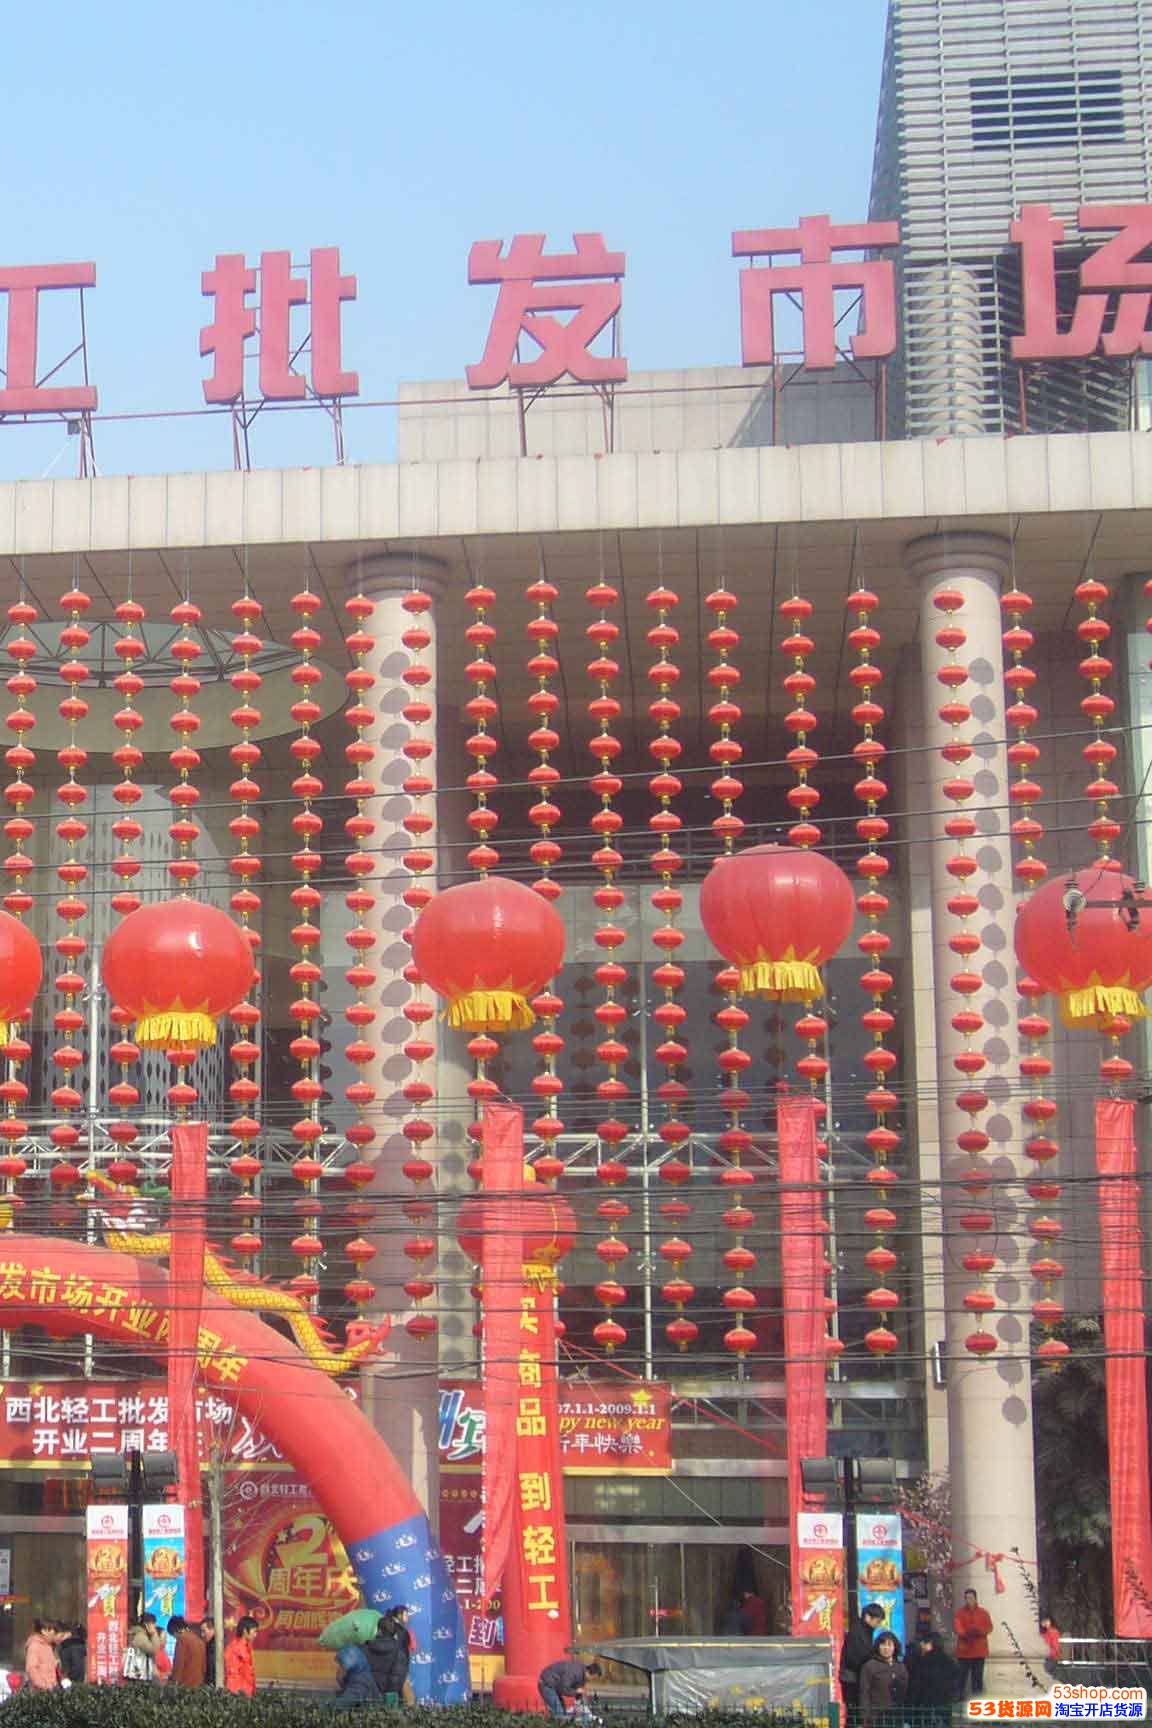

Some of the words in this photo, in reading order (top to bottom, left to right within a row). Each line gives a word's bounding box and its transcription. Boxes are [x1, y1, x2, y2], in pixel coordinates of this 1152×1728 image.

[624, 1417, 666, 1433] year
[32, 1429, 203, 1456] 开业二周年
[518, 1472, 559, 1609] 到轻工
